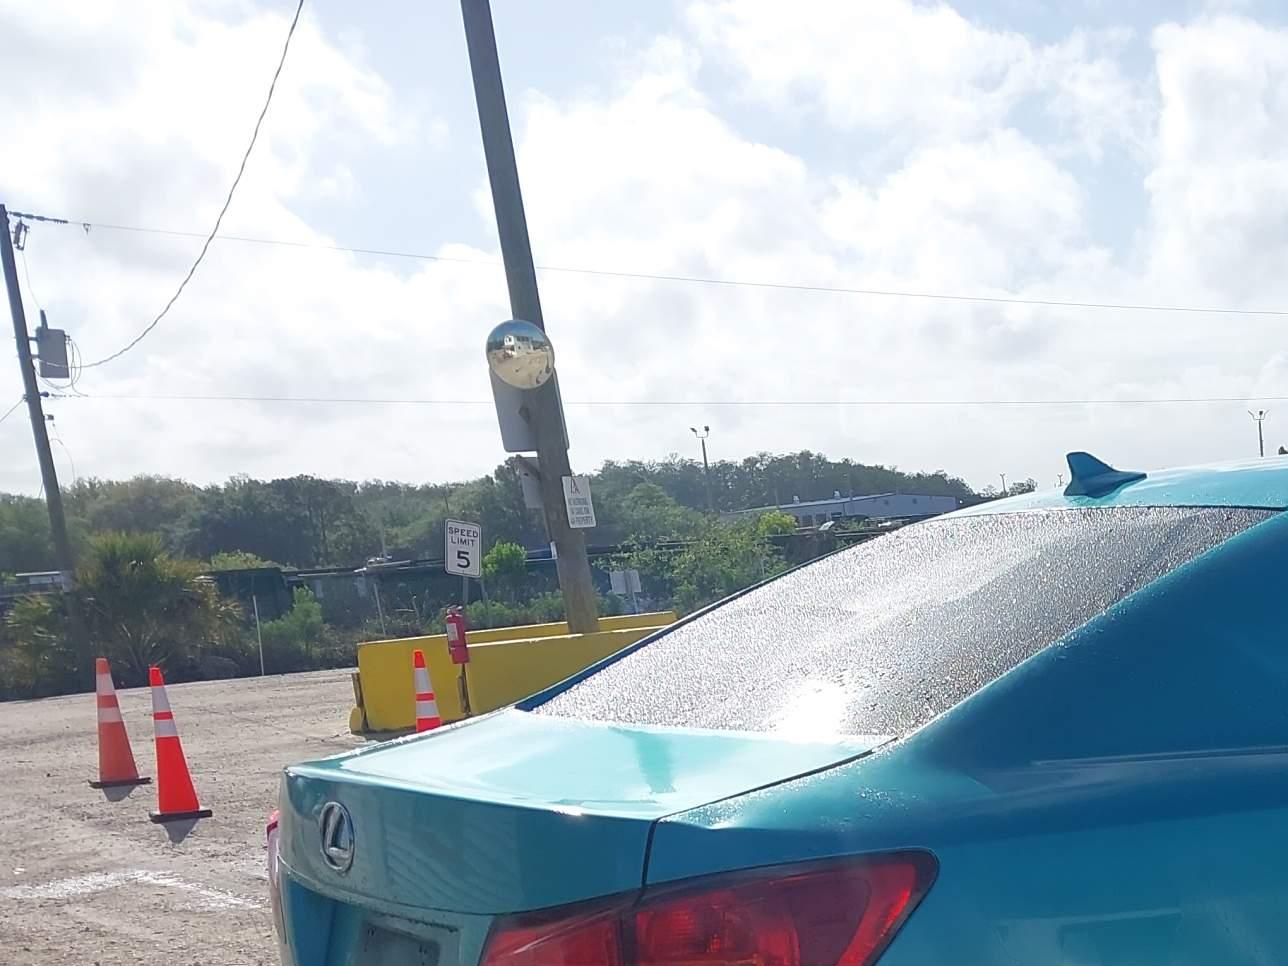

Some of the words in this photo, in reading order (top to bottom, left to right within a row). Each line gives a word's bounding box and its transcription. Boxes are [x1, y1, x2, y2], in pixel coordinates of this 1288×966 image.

[448, 526, 479, 538] SPEED
[450, 536, 475, 547] LIMIT
[456, 550, 471, 569] 5
